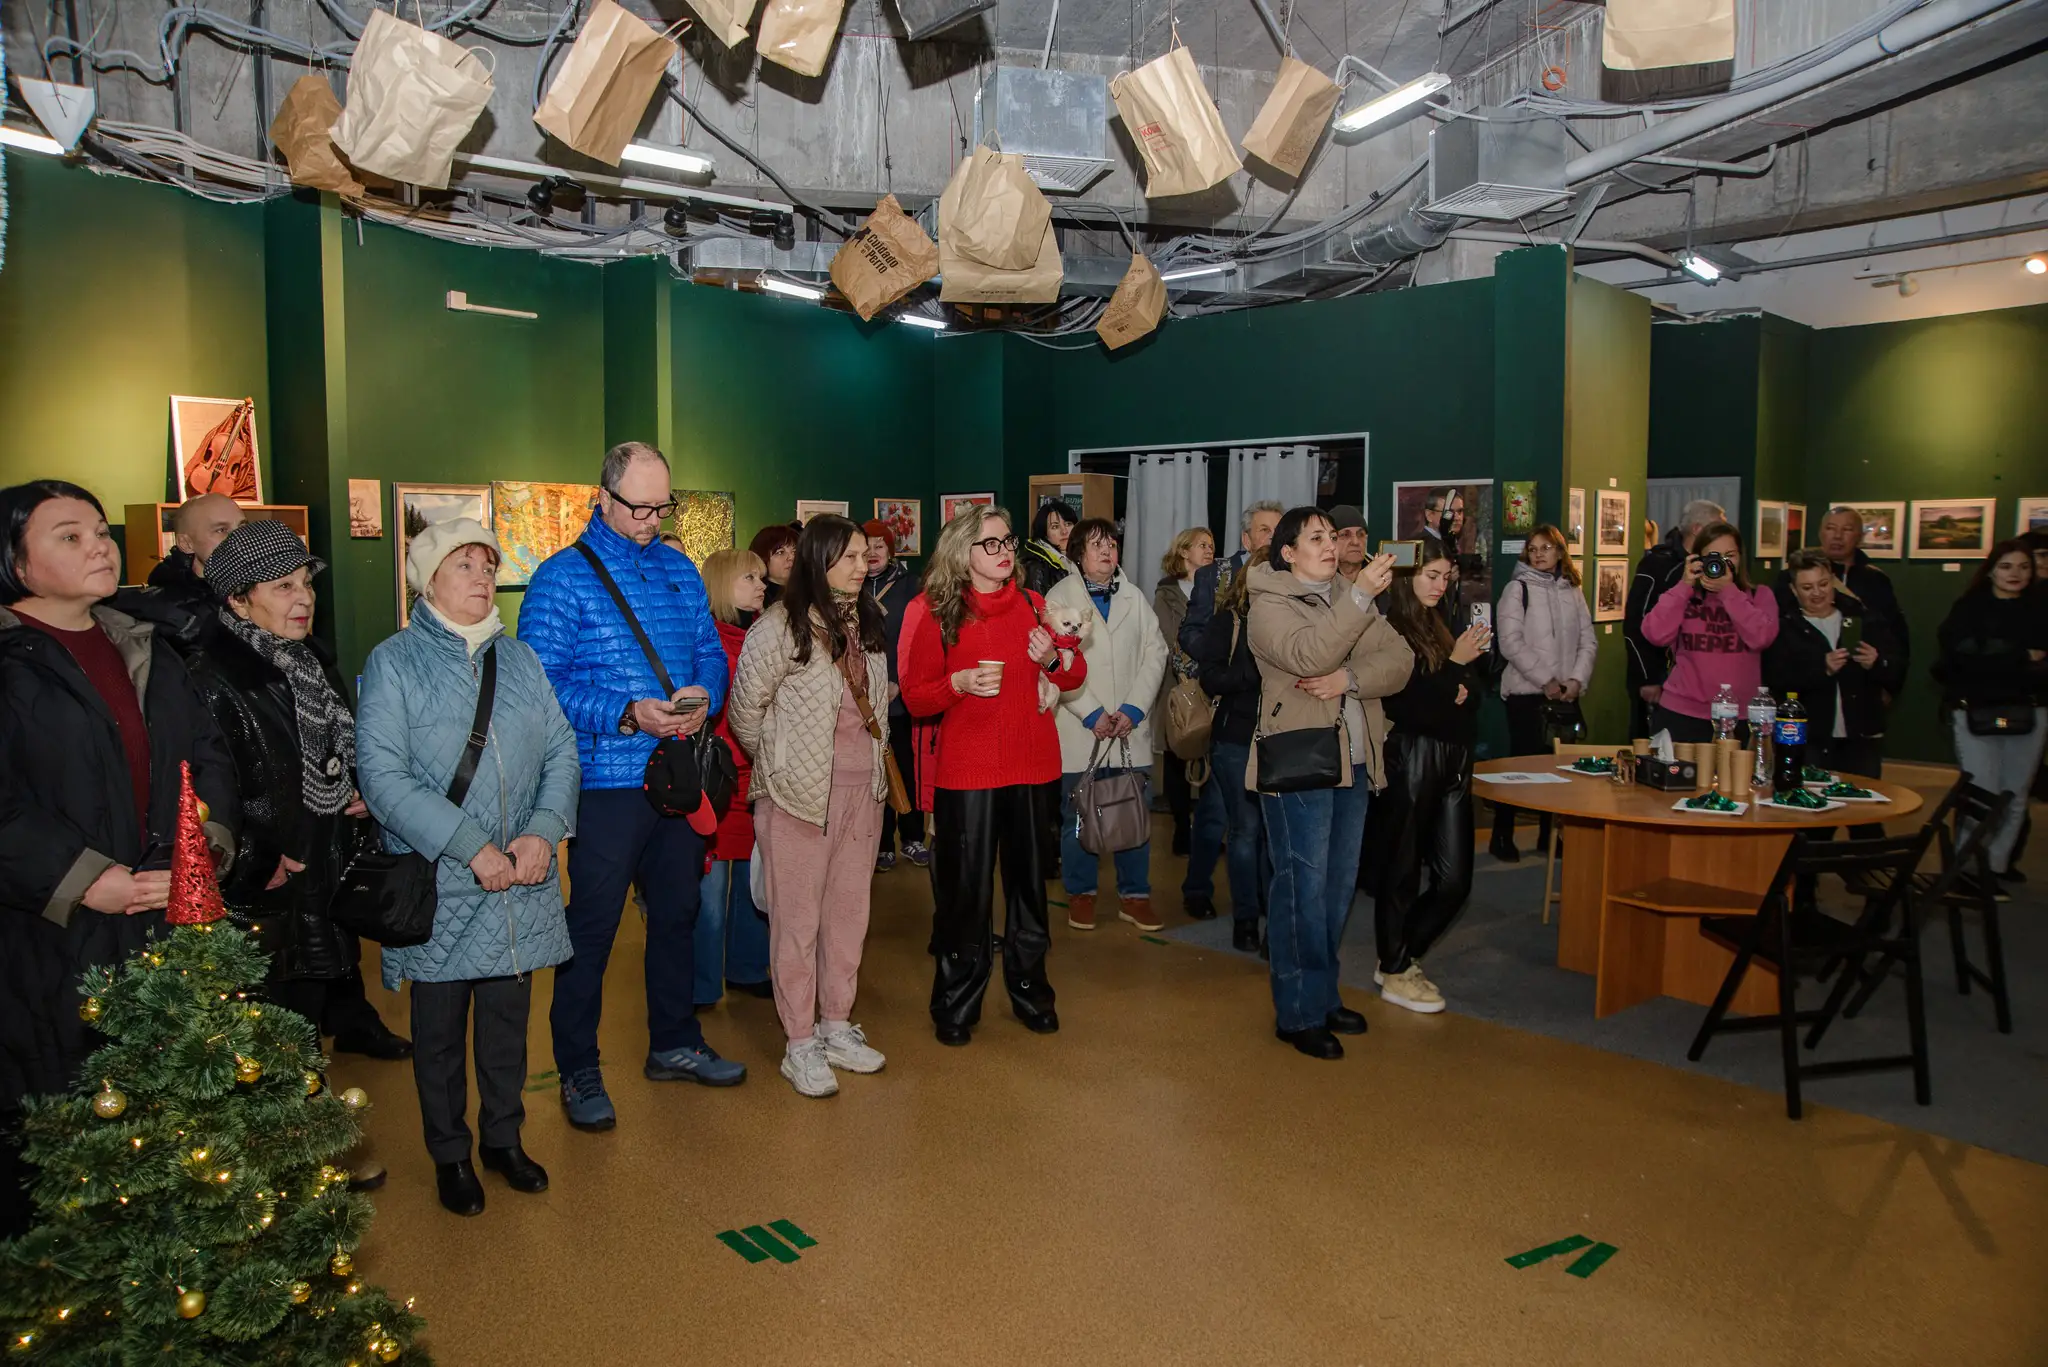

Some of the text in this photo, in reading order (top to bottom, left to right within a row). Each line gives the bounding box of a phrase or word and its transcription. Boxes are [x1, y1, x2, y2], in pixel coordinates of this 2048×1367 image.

[865, 249, 888, 274] Perro
[866, 233, 899, 268] Cuidado
[1681, 632, 1751, 653] REPEA
